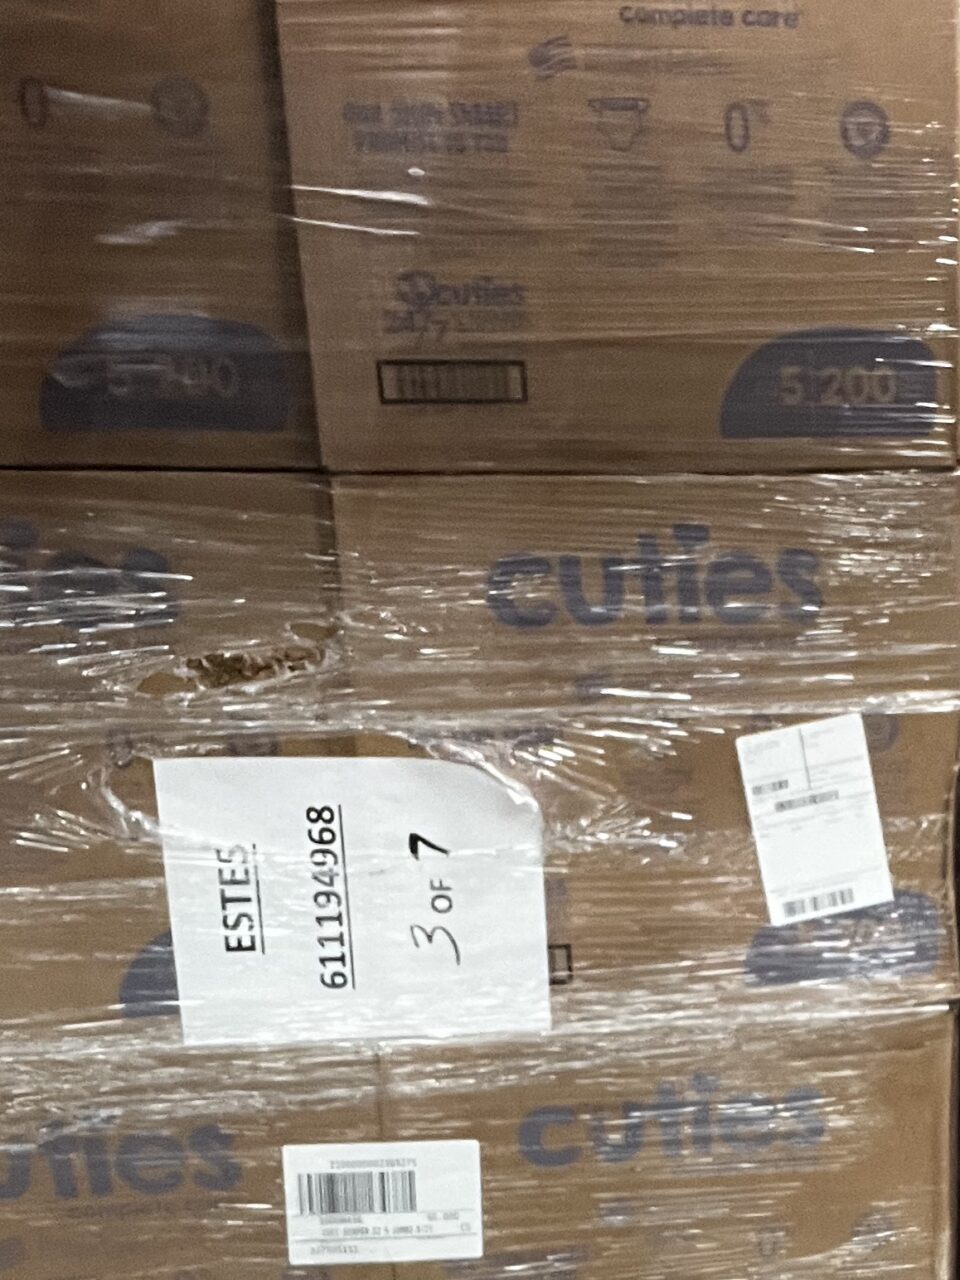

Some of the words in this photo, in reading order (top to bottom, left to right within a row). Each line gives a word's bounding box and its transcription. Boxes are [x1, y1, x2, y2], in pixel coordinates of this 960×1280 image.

[486, 523, 825, 629] cuties
[216, 844, 257, 952] ESTES
[306, 806, 348, 989] 611194968
[408, 833, 450, 861] 7
[430, 879, 453, 914] OF
